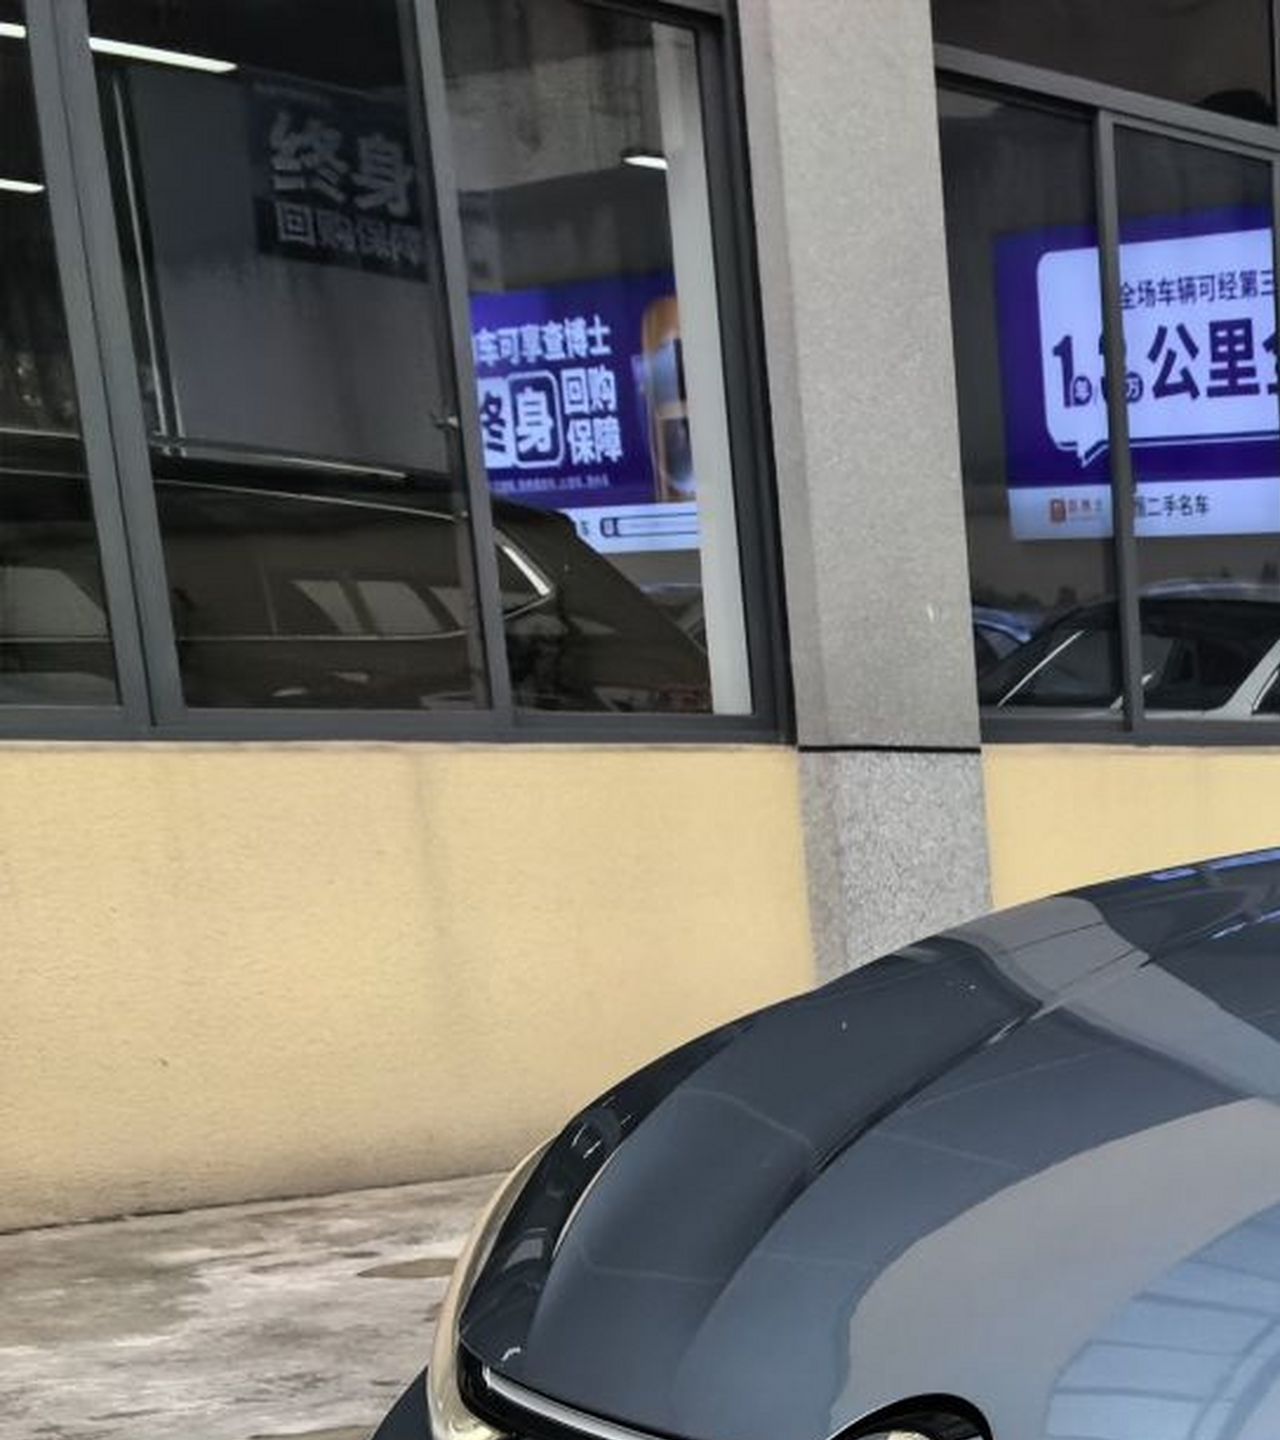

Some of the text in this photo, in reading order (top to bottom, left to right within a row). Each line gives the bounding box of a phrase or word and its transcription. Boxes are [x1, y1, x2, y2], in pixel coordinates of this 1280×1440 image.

[269, 111, 415, 217] 终身
[473, 314, 612, 366] 车可享查博士
[561, 364, 617, 415] 回购
[567, 416, 623, 465] 保障
